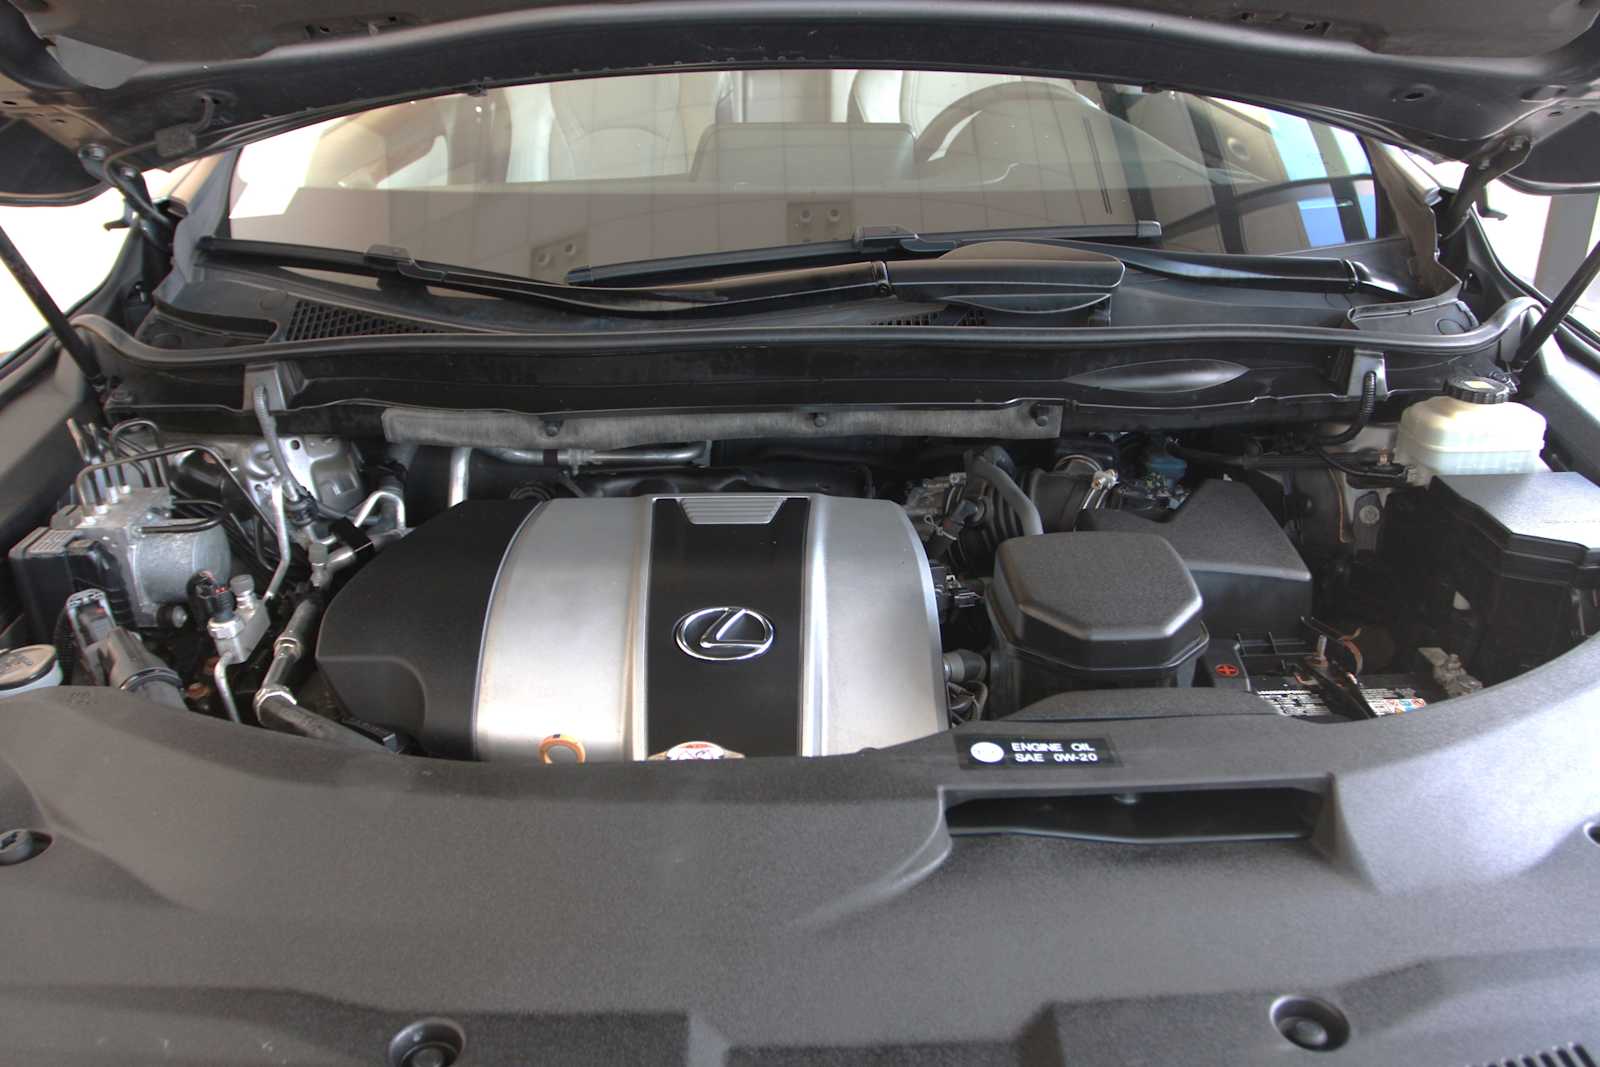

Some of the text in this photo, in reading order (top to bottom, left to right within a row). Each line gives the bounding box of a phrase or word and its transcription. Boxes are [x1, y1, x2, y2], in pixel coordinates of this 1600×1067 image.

[1010, 741, 1096, 752] ENGINE OIL
[1014, 752, 1045, 763] SAE
